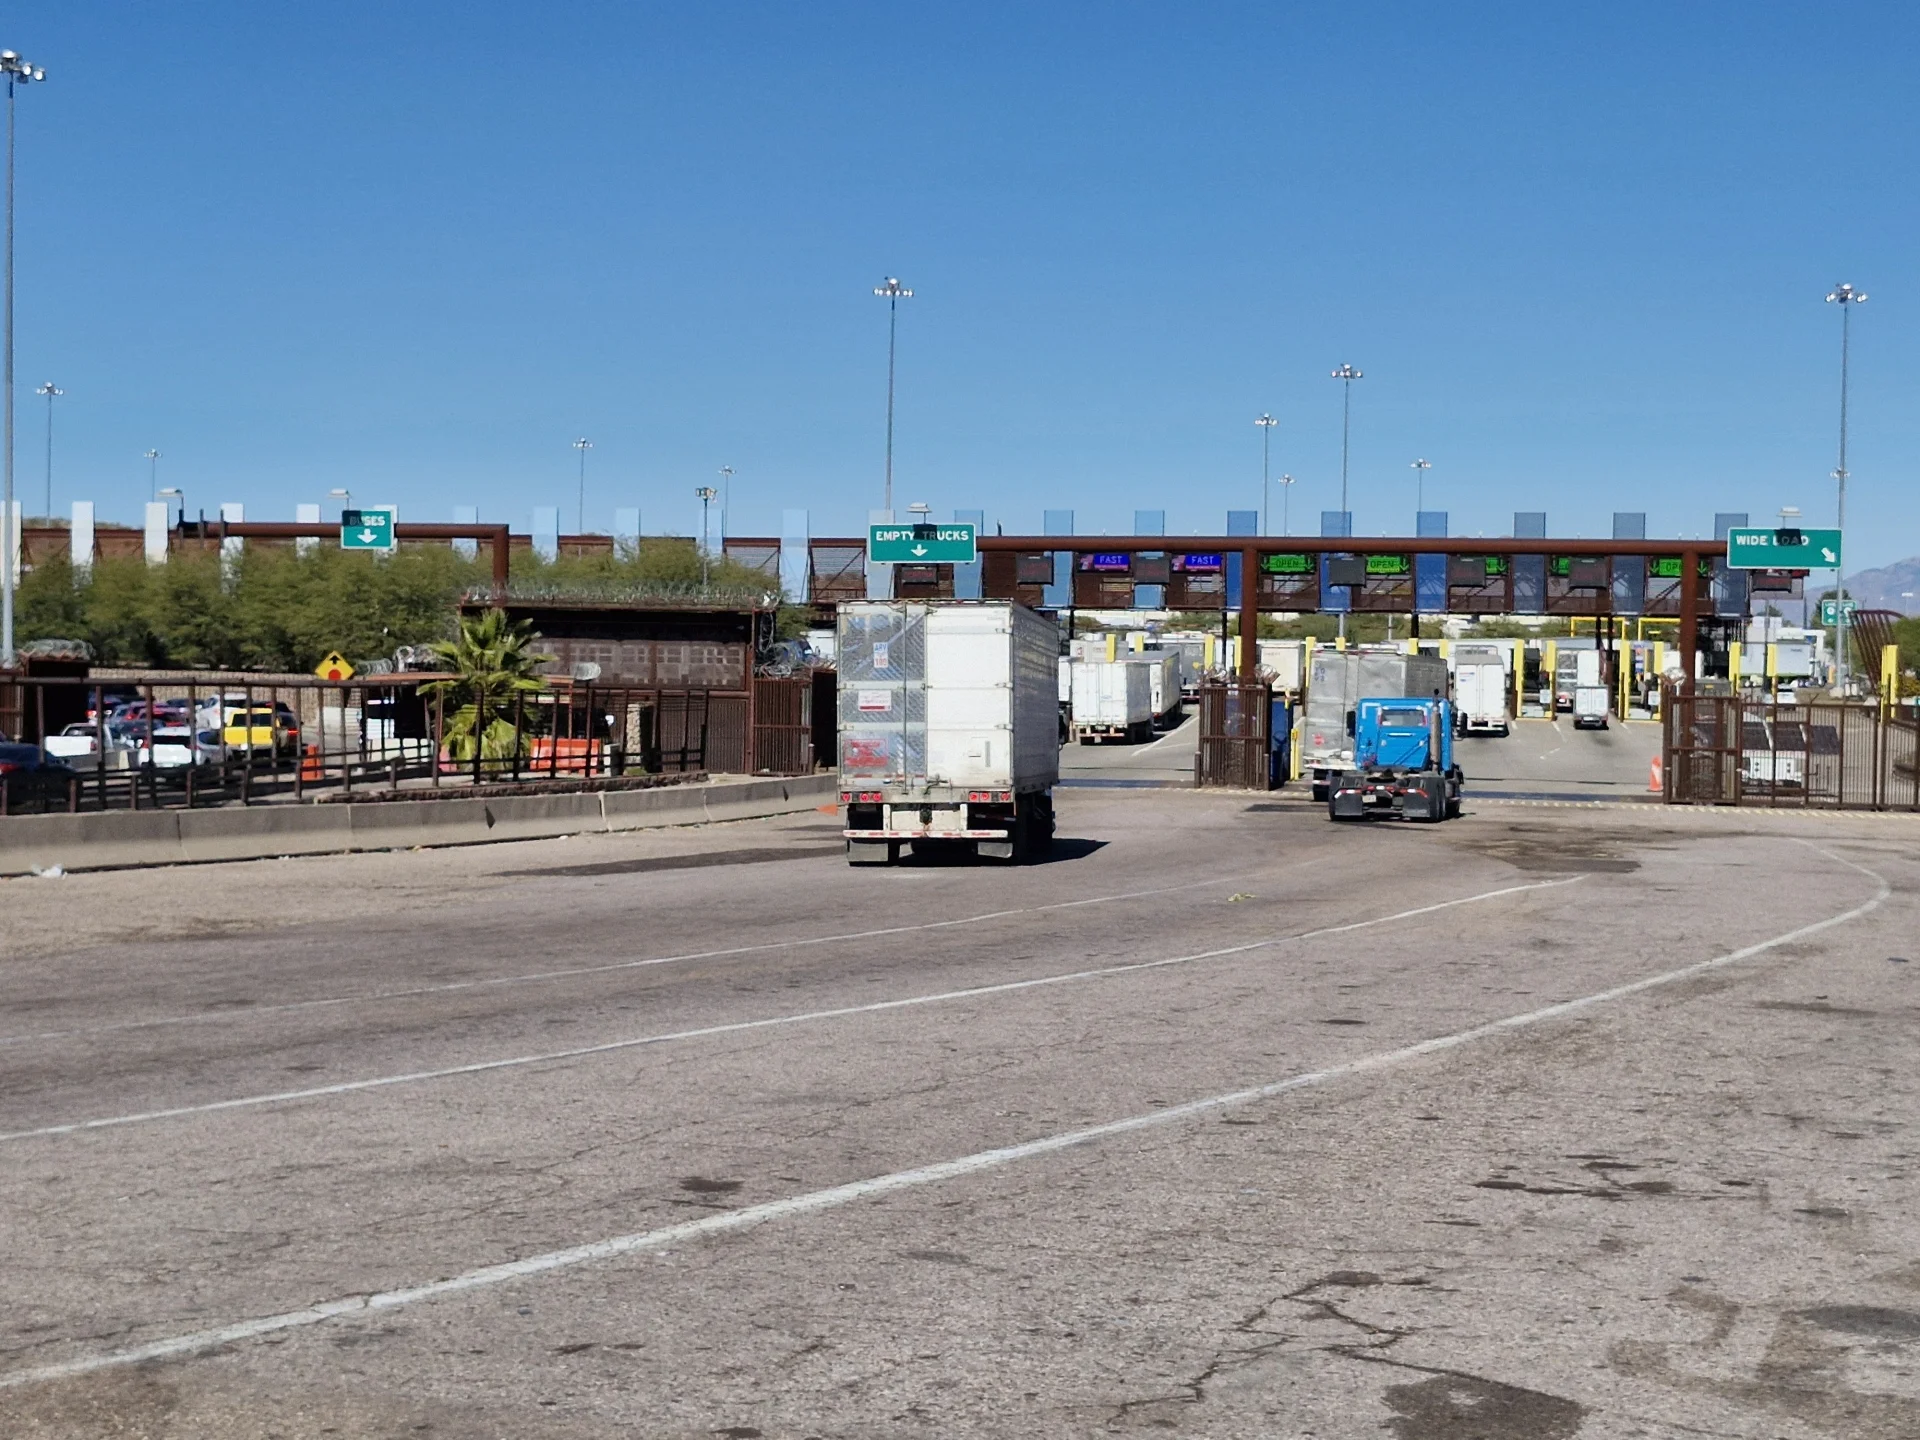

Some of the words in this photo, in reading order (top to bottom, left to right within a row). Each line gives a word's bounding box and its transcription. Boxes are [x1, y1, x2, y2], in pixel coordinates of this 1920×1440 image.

[875, 531, 915, 541] EMPTY
[922, 531, 969, 541] TRUCKS
[1736, 535, 1768, 546] WIDE
[1773, 535, 1809, 546] LOAD
[1099, 555, 1122, 564] FAST
[1191, 555, 1214, 565] FAST
[1276, 560, 1300, 568] OPEN
[1370, 560, 1395, 568] OPEN
